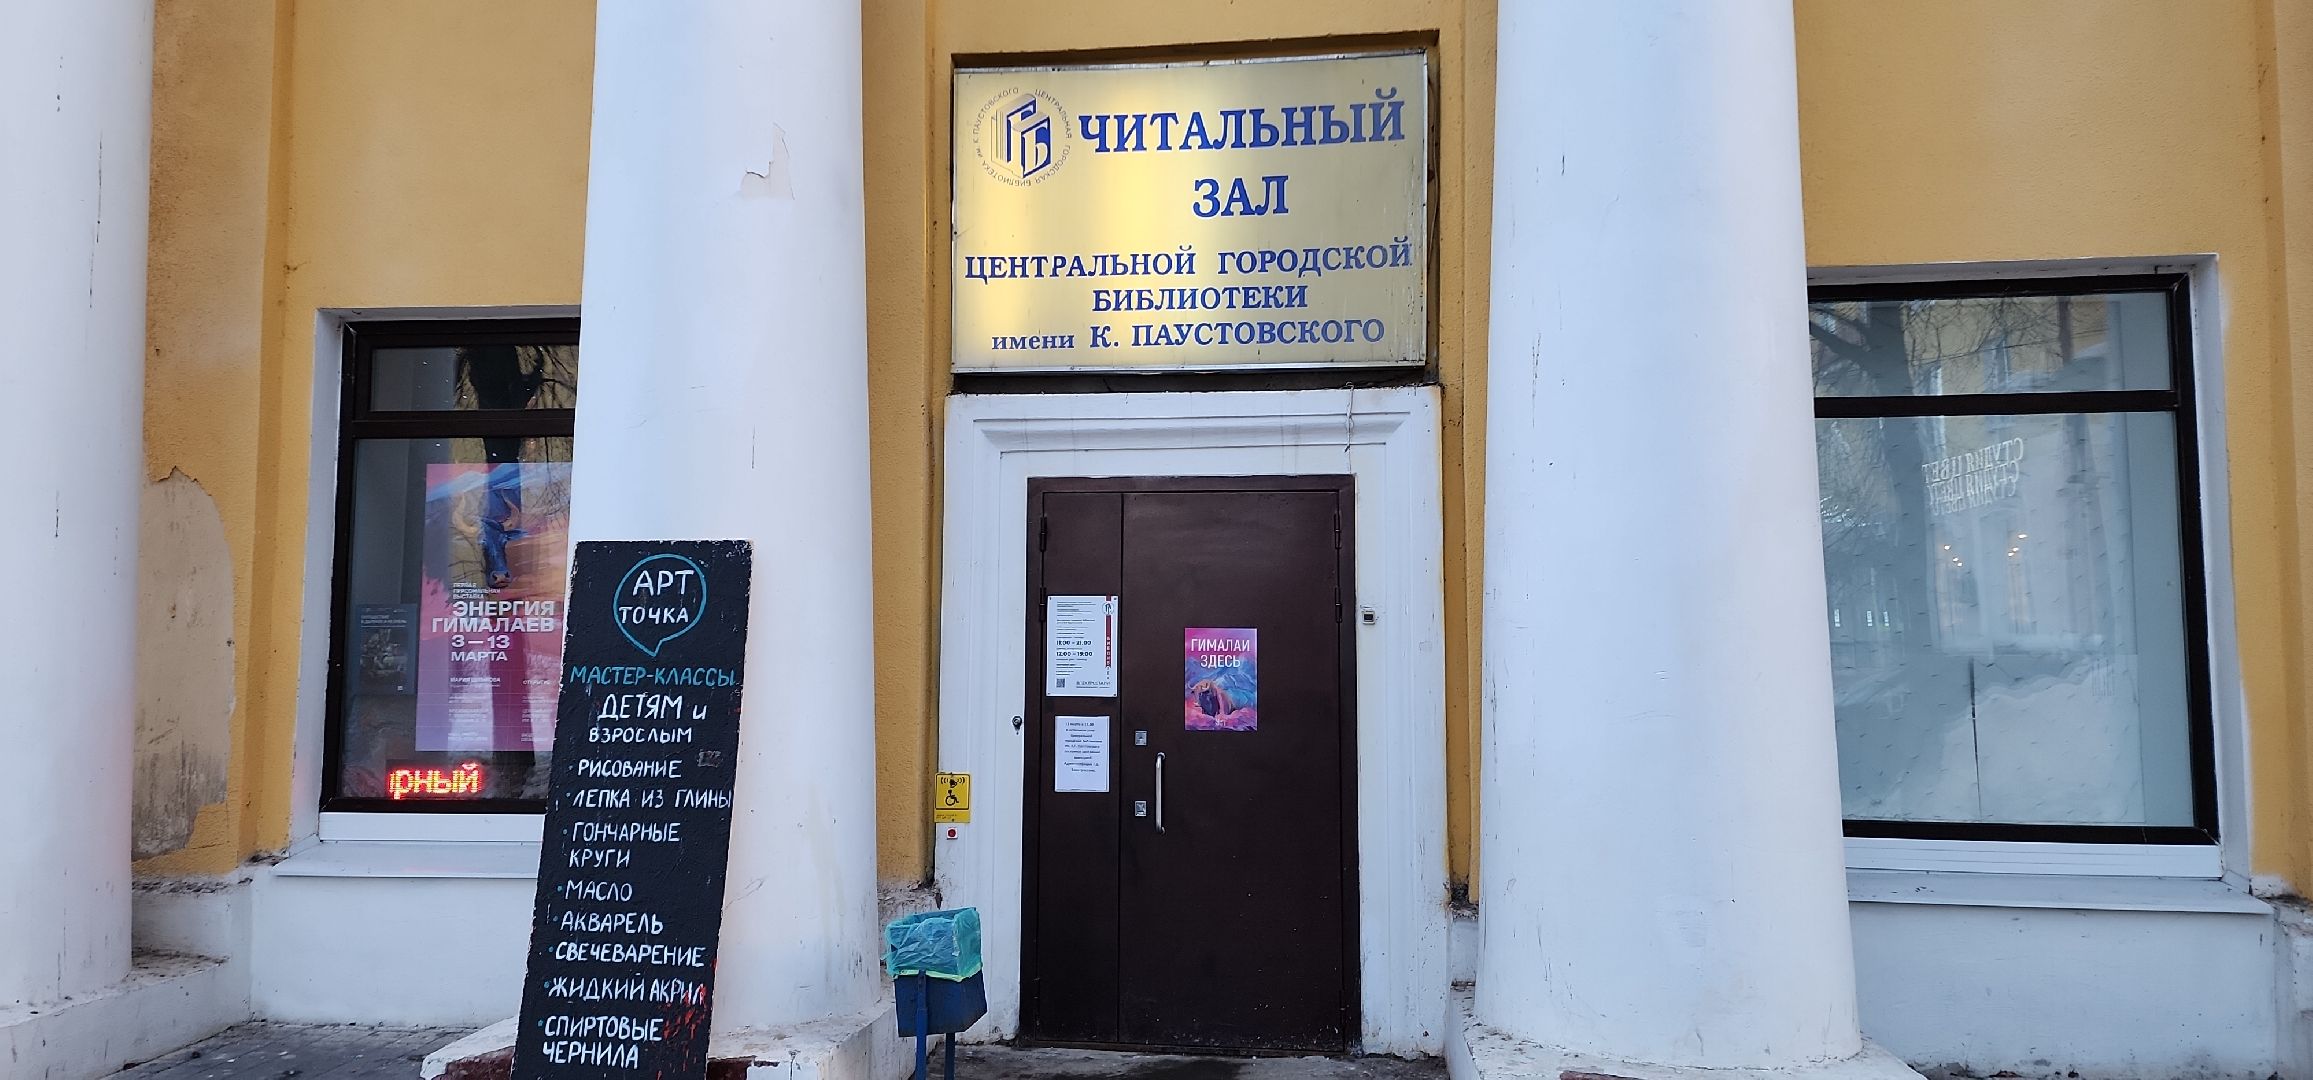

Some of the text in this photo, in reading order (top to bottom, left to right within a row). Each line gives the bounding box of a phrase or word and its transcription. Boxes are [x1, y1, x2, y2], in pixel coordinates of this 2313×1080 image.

[972, 87, 1019, 134] ПАУСТОВСКОГО
[1034, 88, 1073, 139] ЦЕНТРАЛЬНАЯ
[1078, 88, 1405, 153] ЧИТАЛЬНЫЙ
[981, 160, 1032, 187] БИБЛИОТЕКА
[1035, 144, 1071, 184] ГОРОДСКАЯ
[1192, 175, 1289, 219] ЗАЛ
[965, 237, 1412, 283] ЦЕНТРАЛЬНОЙ ГОРОДСКОЙ
[1092, 284, 1308, 312] БИБЛИОТЕКИ
[992, 319, 1385, 350] имени К. ПАУСТОВСКОГО
[632, 569, 695, 597] АРТ
[452, 600, 555, 617] ЭНЕРГИЯ
[618, 606, 690, 625] ТОЧКА
[432, 617, 555, 633] ГИМАЛАЕВ
[451, 634, 465, 649] 3
[487, 634, 510, 649] 13
[1191, 638, 1250, 652] ГИМАЛАИ
[451, 651, 508, 662] МАРТА
[1200, 654, 1241, 668] ЗДЕСЬ
[570, 665, 736, 686] МАСТЕР-КЛАССЫ
[597, 693, 683, 722] ДЕТЯМ
[588, 727, 692, 743] ВЗРОСЛЫМ
[578, 759, 682, 778] РИСОВАНИЕ
[572, 788, 732, 808] ЛЕПКА ИЗ ГЛИНЫ
[572, 822, 681, 842] ГОНЧАРНЫЕ
[569, 849, 631, 868] КРУГИ
[565, 880, 633, 901] МАСЛО
[560, 910, 664, 935] АКВАРЕЛЬ
[555, 941, 706, 967] СВЕЧЕВАРЕНИЕ
[548, 972, 704, 1005] ЖИДКИЙ АКРИЛ
[544, 1015, 664, 1042] СПИРТОВЫЕ
[542, 1041, 639, 1069] ЧЕРНИЛА
